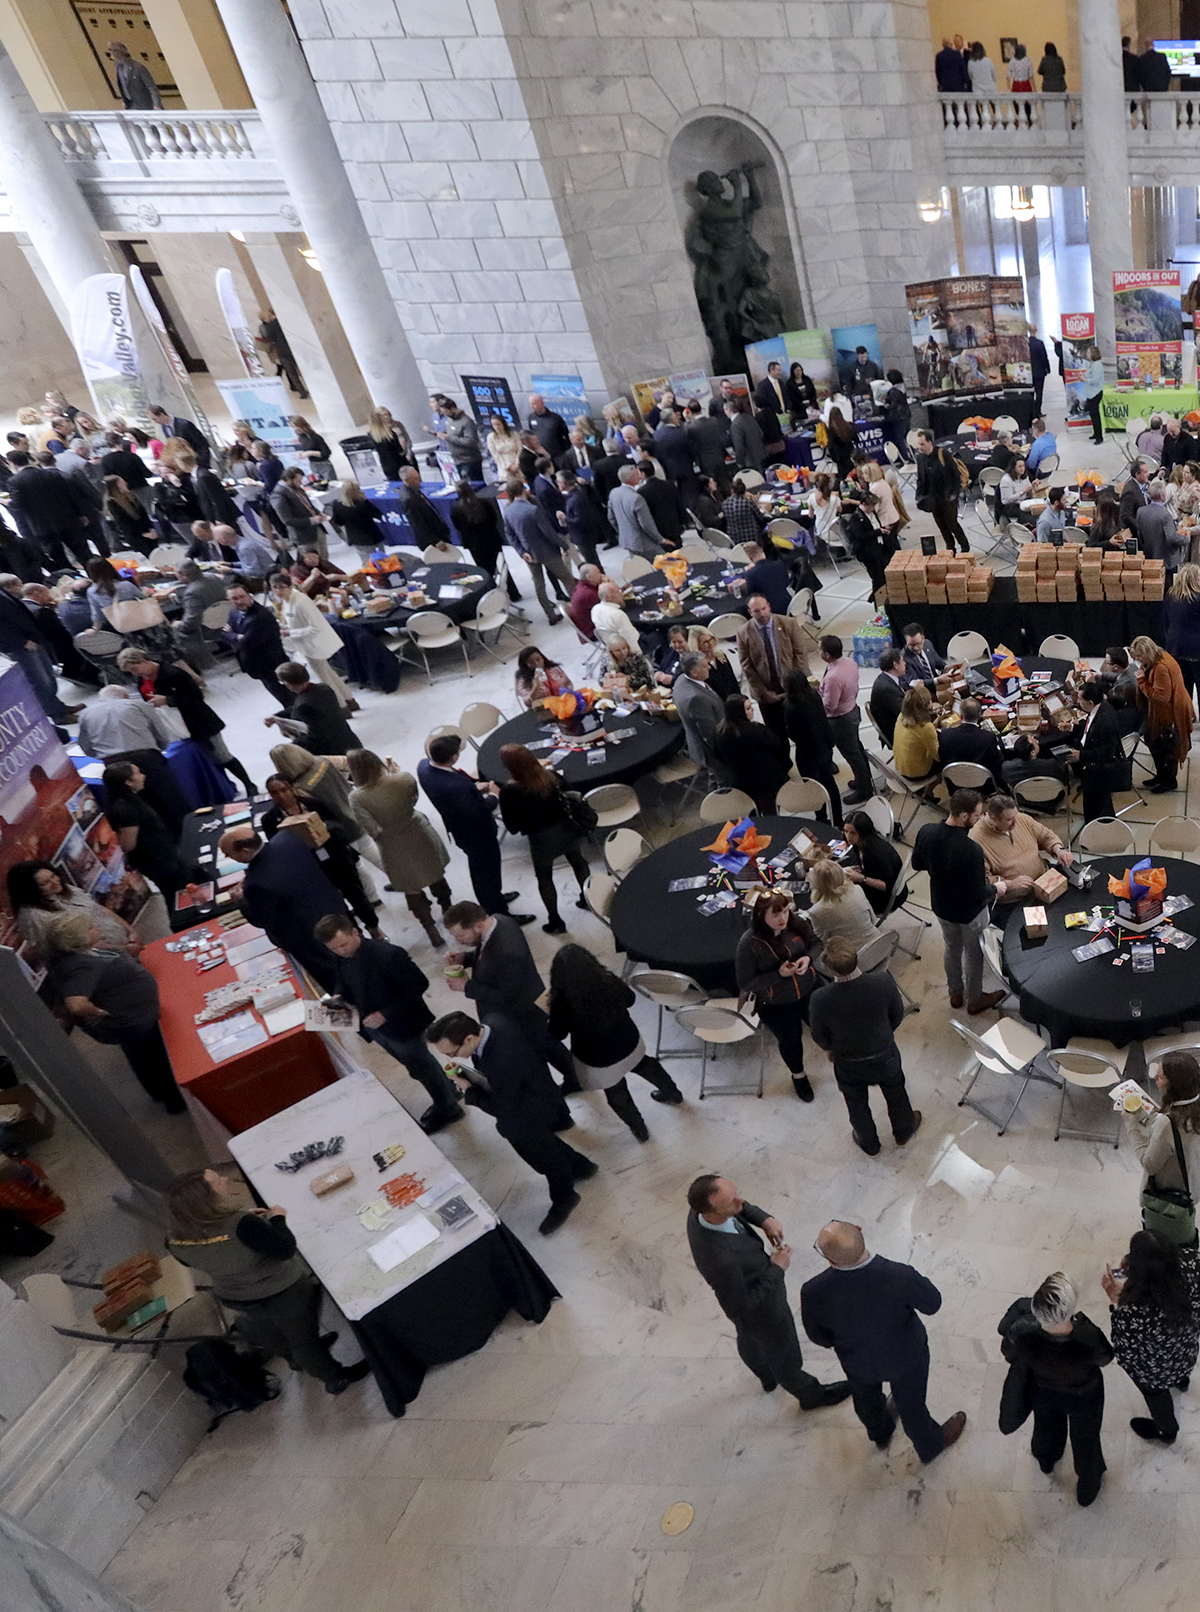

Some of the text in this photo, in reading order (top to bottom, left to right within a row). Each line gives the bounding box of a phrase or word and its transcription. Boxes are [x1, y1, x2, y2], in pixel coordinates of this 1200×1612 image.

[1114, 272, 1152, 286] INDOORS
[1161, 272, 1179, 281] OUT
[952, 282, 987, 294] BONES
[1065, 317, 1090, 332] LOGAN
[472, 385, 492, 396] 500
[1102, 404, 1129, 419] LOGAN
